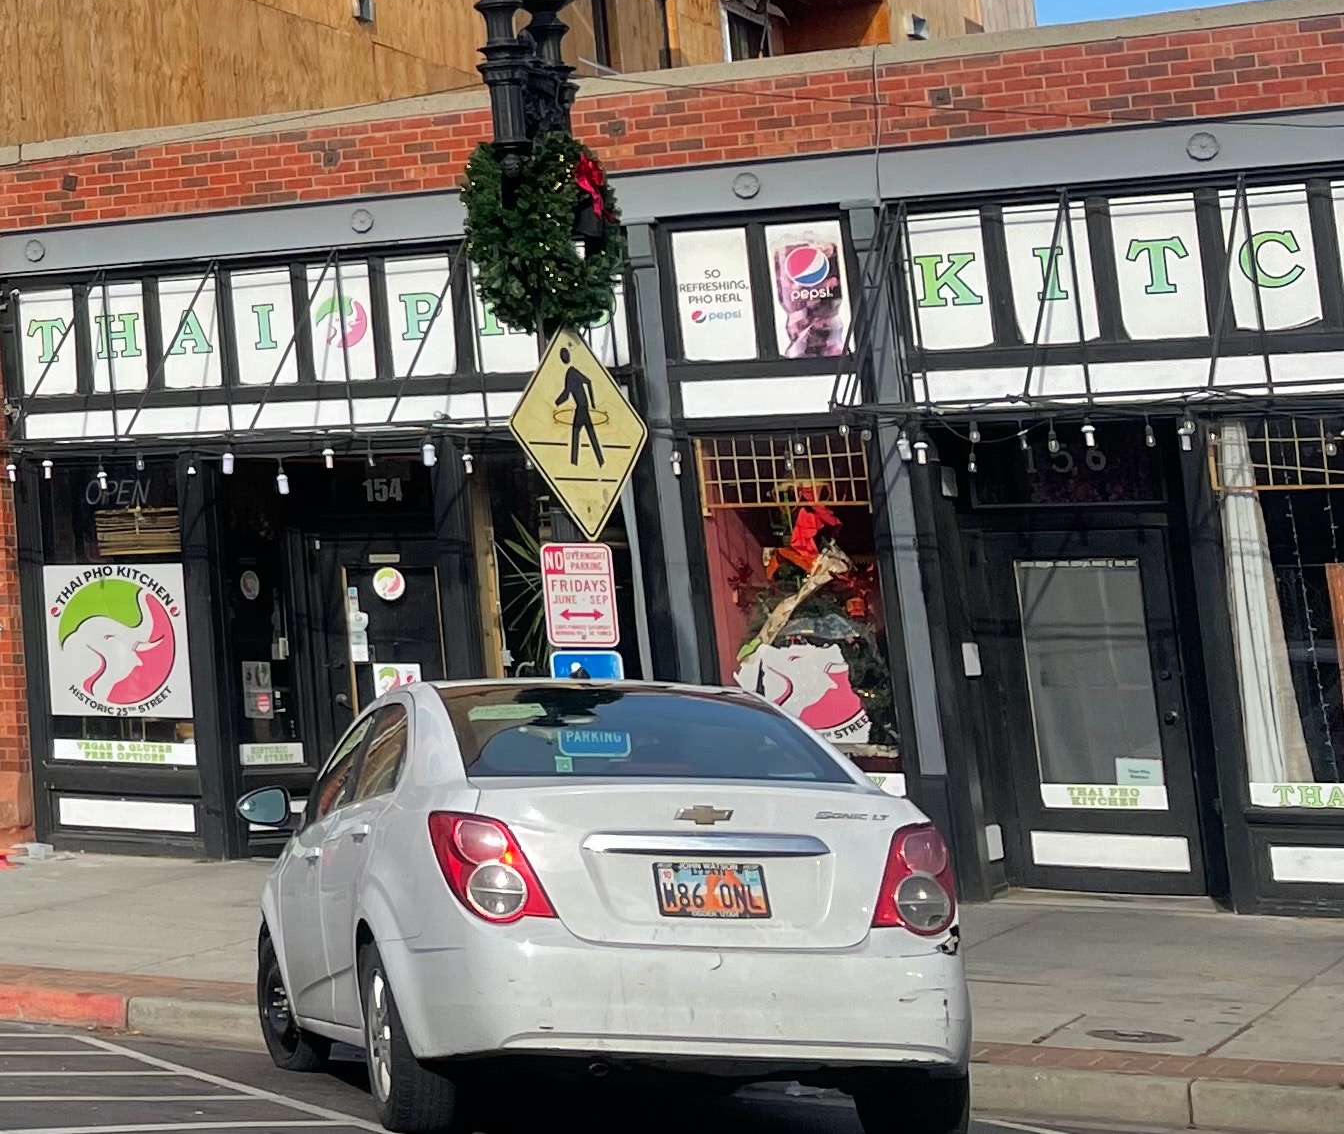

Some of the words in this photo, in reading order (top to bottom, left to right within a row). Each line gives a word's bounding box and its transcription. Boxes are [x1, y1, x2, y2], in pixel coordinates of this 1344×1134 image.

[704, 269, 721, 279] SO
[913, 230, 1306, 308] KITC
[688, 294, 712, 304] PHO
[715, 293, 743, 303] REAL
[790, 287, 831, 302] pepsi
[708, 309, 742, 322] pepsi
[26, 303, 278, 363] THAI
[85, 479, 152, 505] OPEN
[362, 478, 403, 502] 154
[544, 551, 564, 571] NO
[566, 552, 606, 561] OVERNIGHT
[570, 562, 603, 571] PARKING
[55, 576, 84, 605] THAI
[83, 566, 113, 583] PHO
[116, 566, 174, 606] KITCHEN
[551, 579, 607, 593] FRIDAYS
[553, 595, 577, 605] JUNE
[589, 595, 609, 605] SEP
[69, 684, 115, 715] HISTORIC
[139, 686, 172, 713] STREET
[565, 730, 622, 743] PARKING
[76, 742, 112, 752] VEGAN
[128, 743, 172, 754] GLUTEN
[84, 751, 114, 761] FREE
[117, 752, 166, 762] OPTIONS
[1067, 787, 1104, 797] THAI
[1109, 788, 1140, 797] PHO
[1272, 785, 1344, 806] THA
[1071, 797, 1138, 806] KITCHEN
